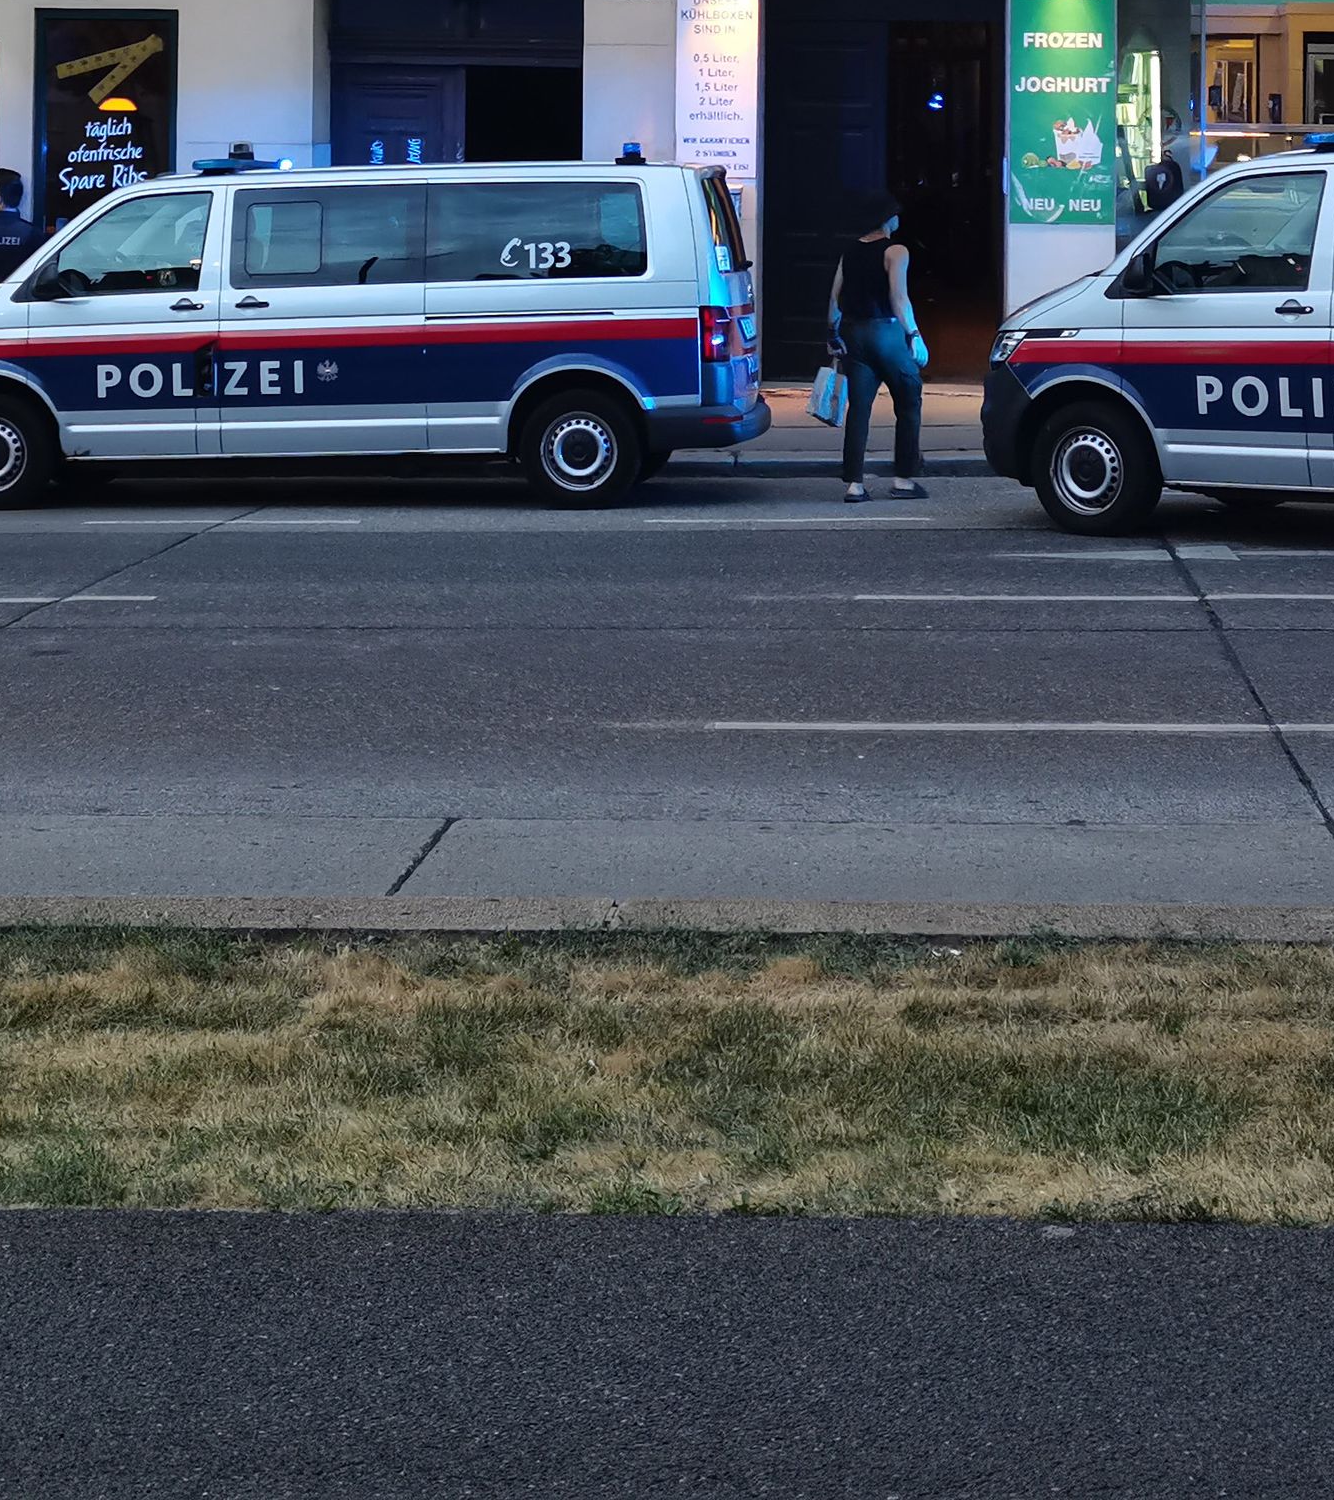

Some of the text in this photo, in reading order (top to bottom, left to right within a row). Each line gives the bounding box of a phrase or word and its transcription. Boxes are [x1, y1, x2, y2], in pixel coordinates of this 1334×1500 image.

[680, 8, 753, 20] KÜHLBOXEN
[694, 24, 721, 34] SIND
[1023, 32, 1103, 49] FROZEN
[694, 53, 709, 64] 0,5
[699, 68, 704, 77] 1
[695, 82, 711, 93] 1,5
[1015, 77, 1110, 93] JOGHURT
[699, 96, 734, 106] 2 Liter
[689, 111, 744, 121] erhältlich.
[84, 116, 132, 143] täglich
[67, 141, 143, 162] ofenfrische
[58, 163, 148, 198] Spare Ribs
[1025, 198, 1055, 211] NEU
[1069, 199, 1101, 212] NEU
[524, 241, 572, 269] 133
